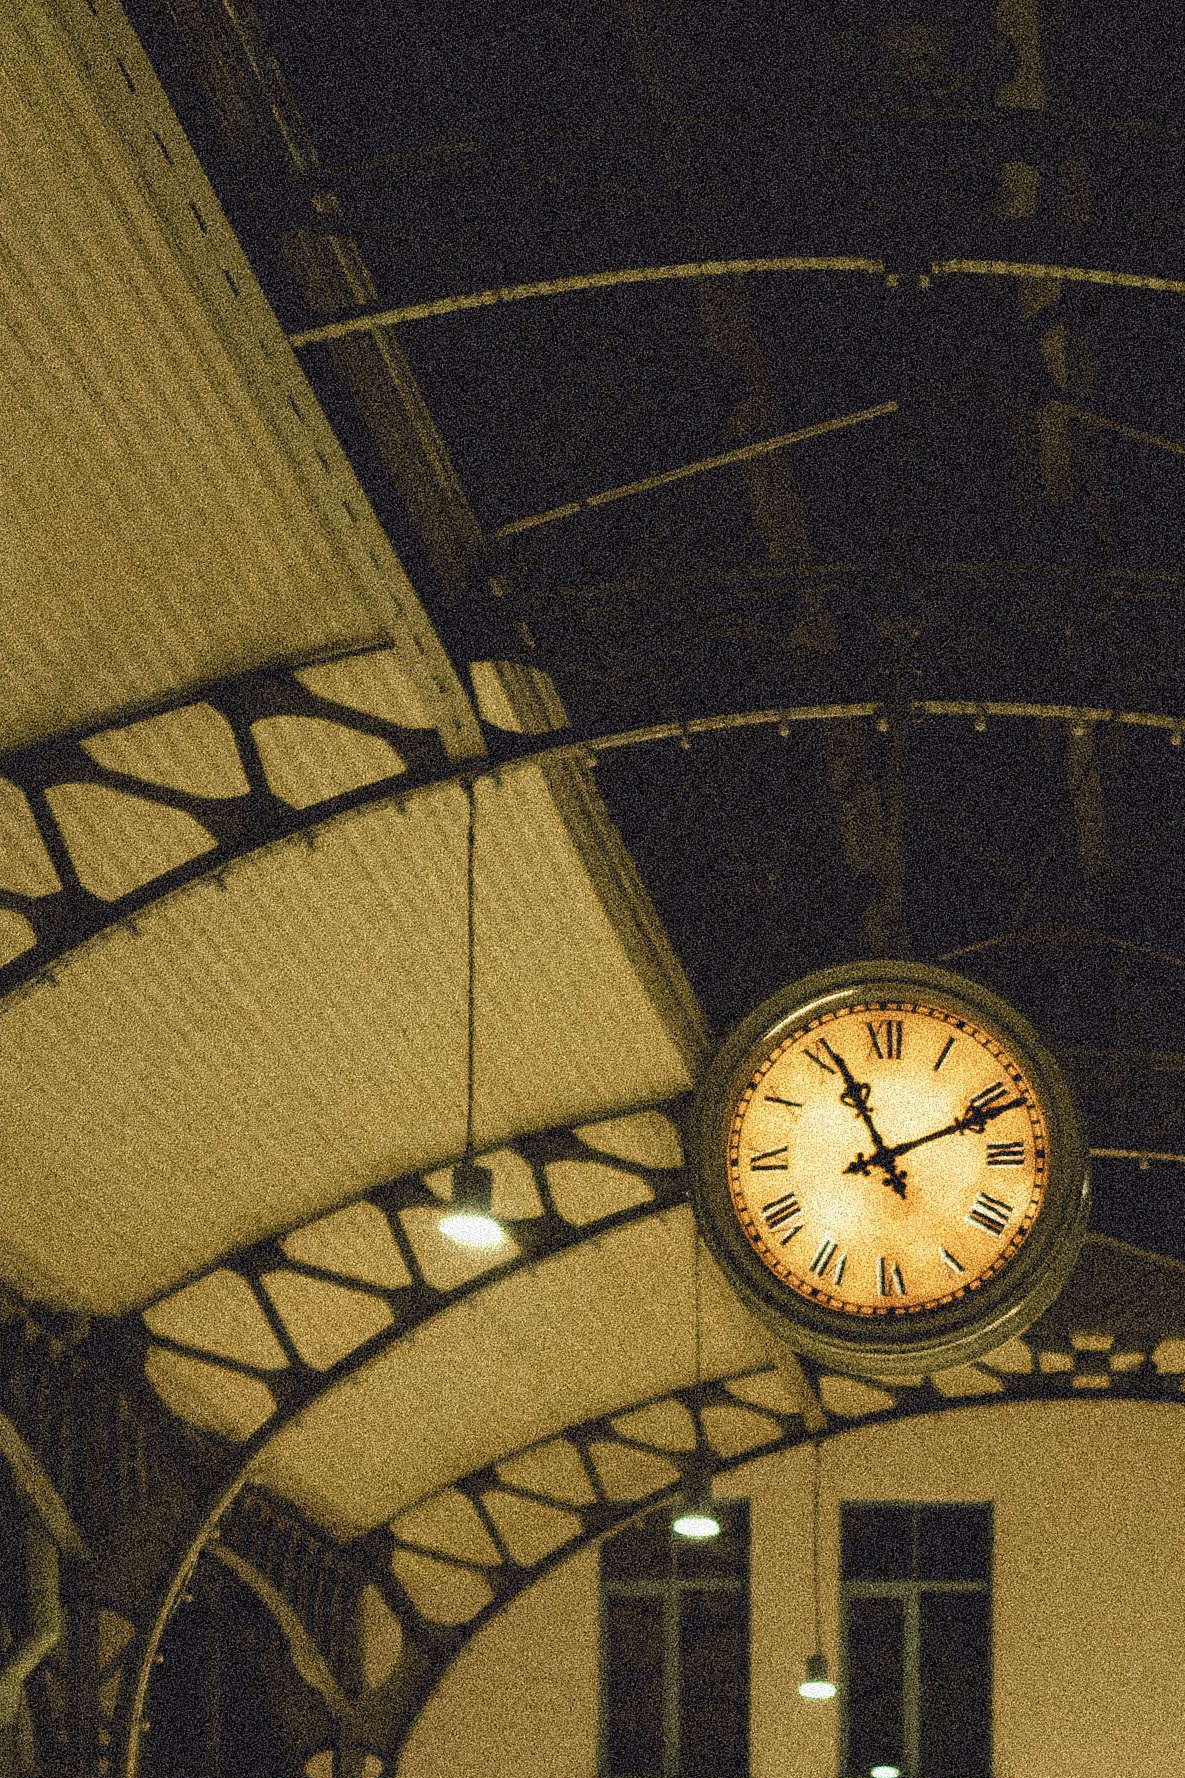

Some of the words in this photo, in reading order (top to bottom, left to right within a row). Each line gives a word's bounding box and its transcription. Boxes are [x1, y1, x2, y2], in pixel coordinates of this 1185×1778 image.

[867, 1020, 903, 1060] XII
[934, 1037, 956, 1072] I
[750, 1145, 789, 1171] IX
[985, 1141, 1025, 1167] III
[762, 1192, 803, 1246] VIII
[809, 1240, 848, 1286] VII
[877, 1257, 907, 1296] VI
